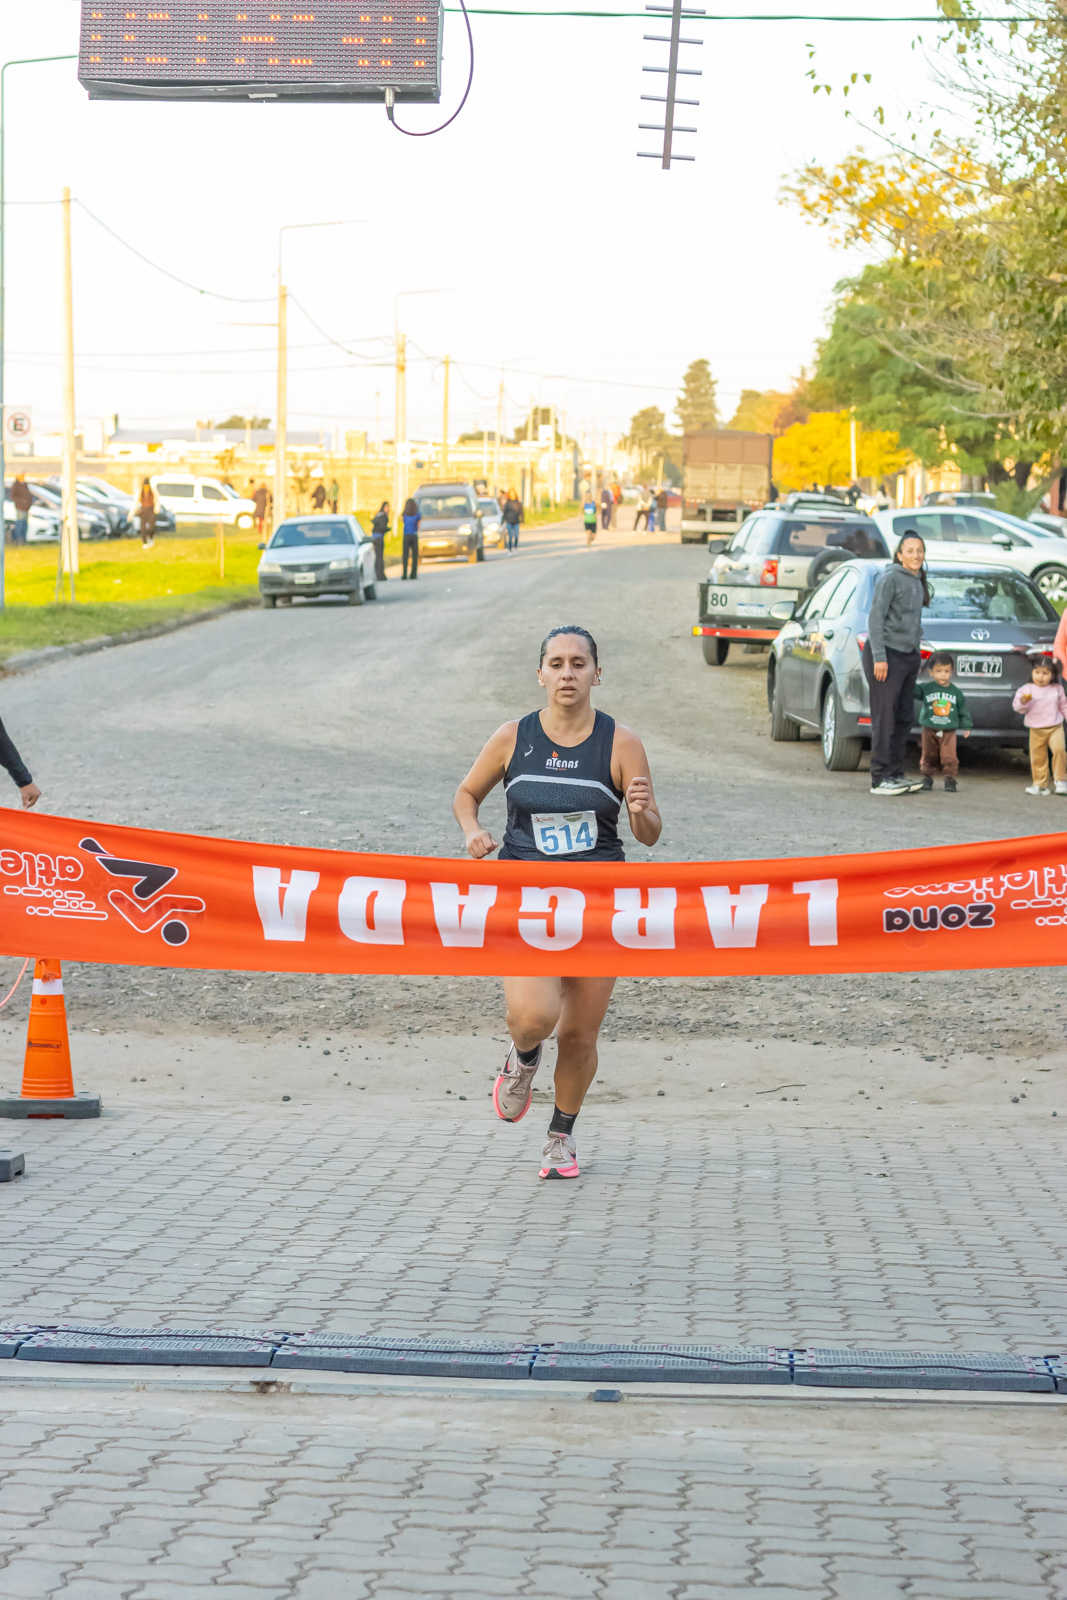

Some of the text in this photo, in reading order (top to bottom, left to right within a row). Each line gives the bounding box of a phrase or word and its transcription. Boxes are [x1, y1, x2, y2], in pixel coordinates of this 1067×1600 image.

[710, 593, 728, 606] 80
[959, 661, 1001, 673] PKT 477
[545, 757, 579, 769] ATENAS
[540, 821, 593, 852] 514
[0, 849, 84, 888] atle
[883, 864, 1067, 903] tletismo
[252, 866, 839, 951] LARGADA
[883, 902, 996, 933] zona
